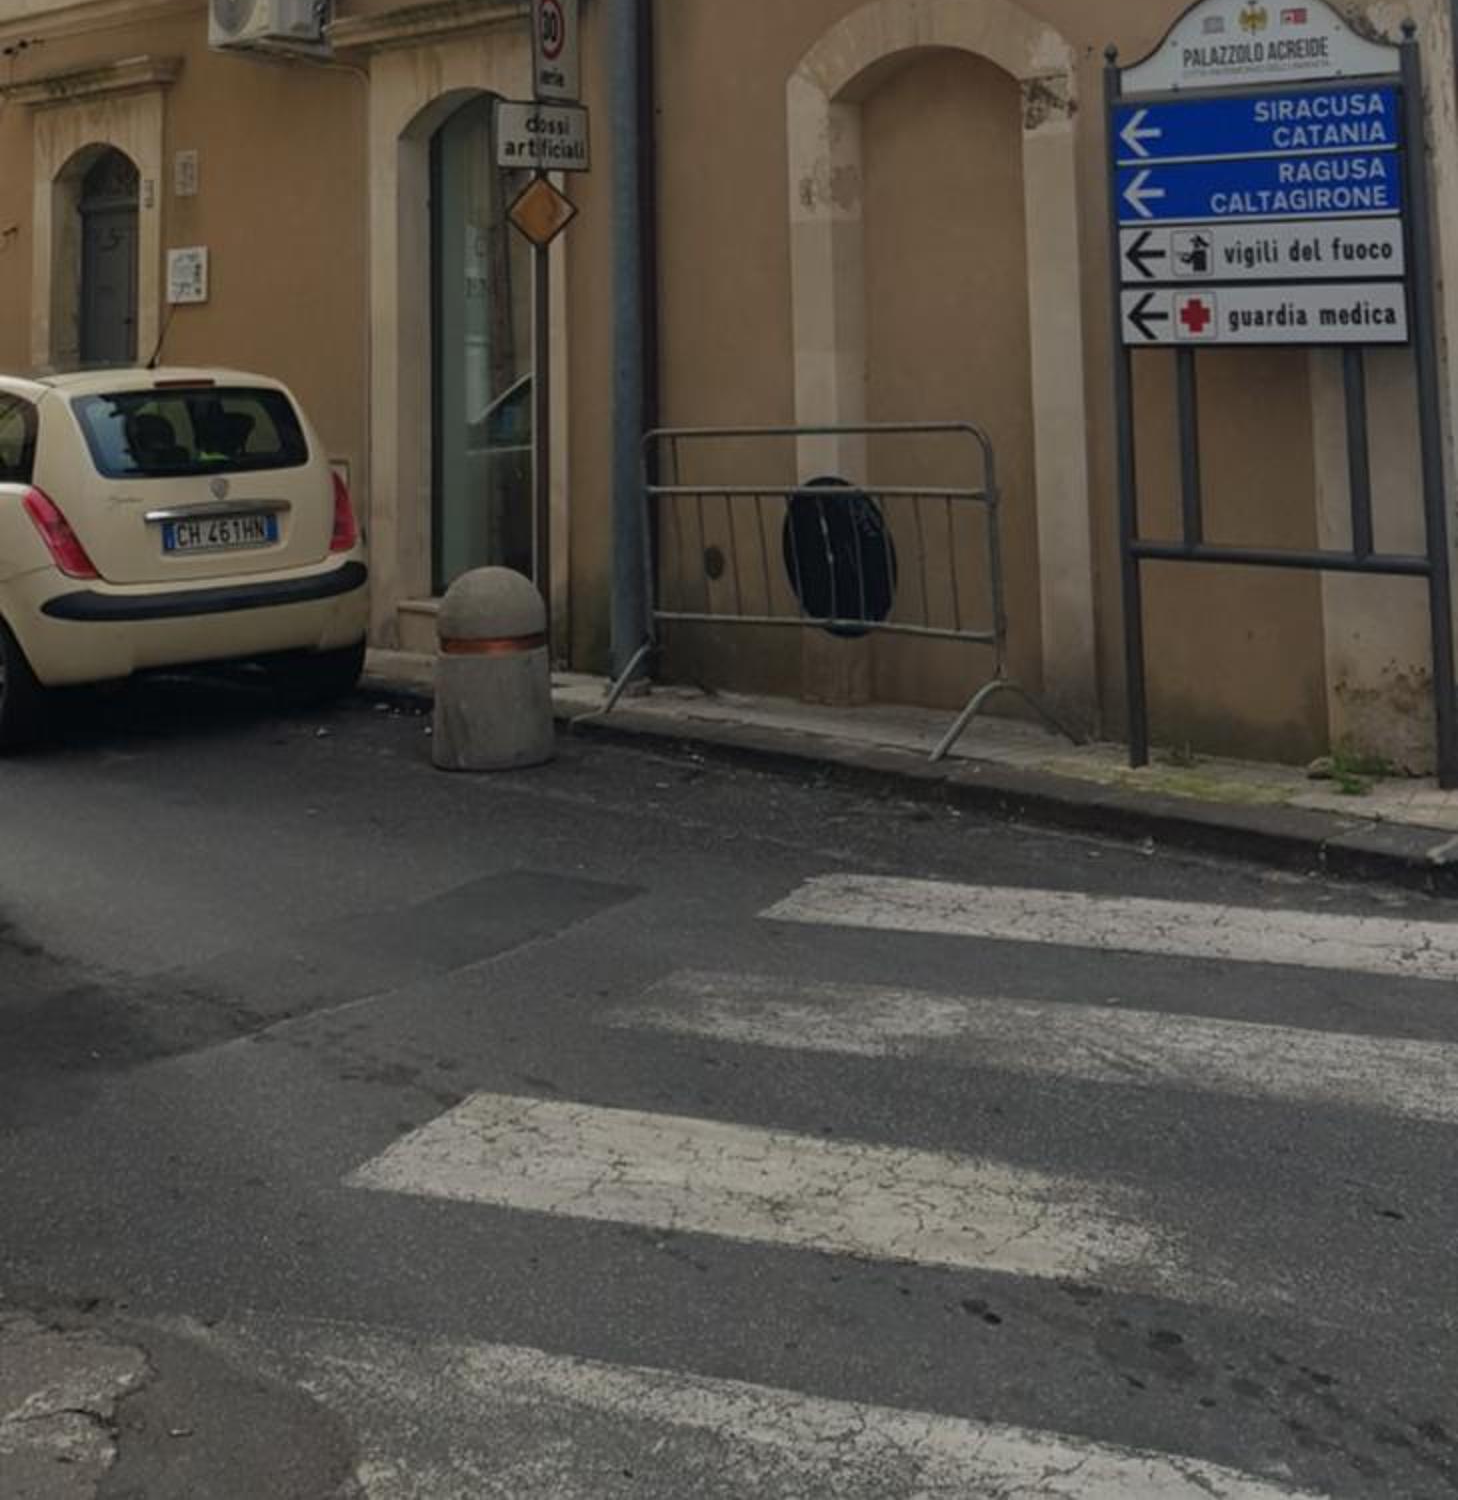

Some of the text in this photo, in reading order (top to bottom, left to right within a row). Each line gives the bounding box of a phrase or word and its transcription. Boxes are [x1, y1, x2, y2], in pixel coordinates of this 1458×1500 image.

[1183, 42, 1264, 67] PALAZZOLO
[1267, 36, 1329, 61] ACREIDE
[1254, 93, 1385, 122] SIRACUSA
[525, 113, 569, 136] dossi
[1272, 121, 1386, 148] CATANIA
[504, 138, 585, 160] artificiali
[1279, 157, 1387, 183] RAGUSA
[1210, 185, 1388, 213] CALTAGIRONE
[1224, 237, 1393, 268] vigili del fuoco
[1228, 301, 1397, 332] guardia medica
[175, 522, 201, 547] CH
